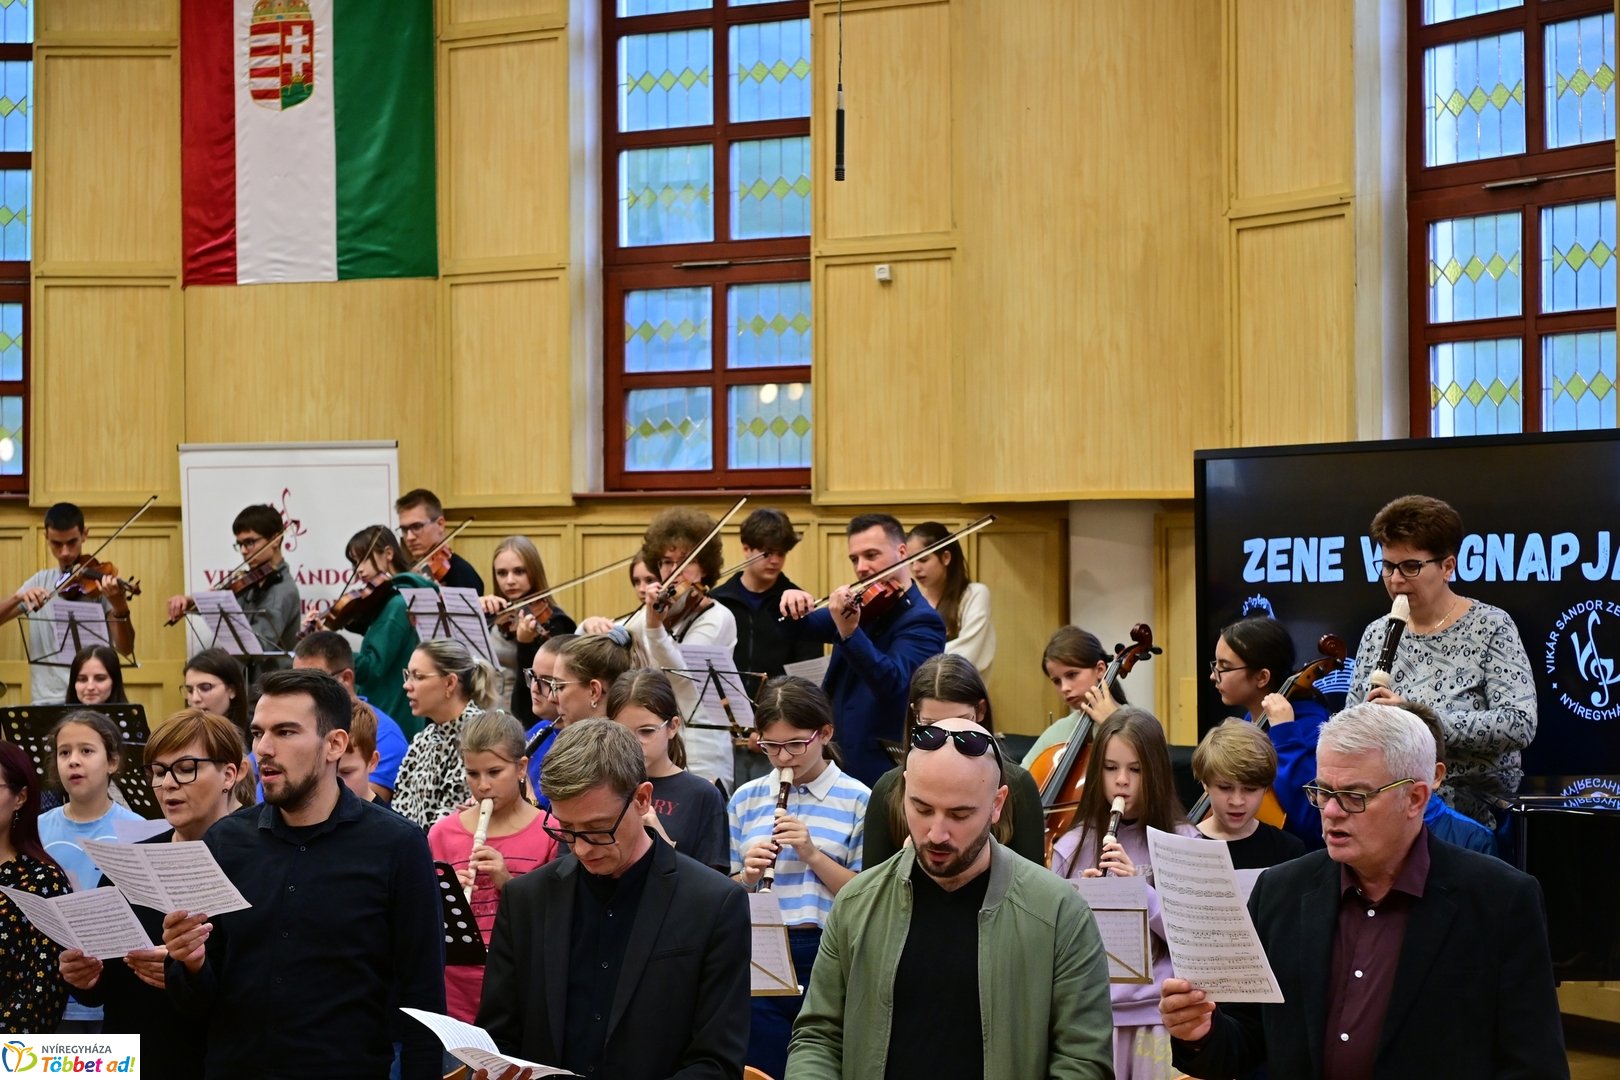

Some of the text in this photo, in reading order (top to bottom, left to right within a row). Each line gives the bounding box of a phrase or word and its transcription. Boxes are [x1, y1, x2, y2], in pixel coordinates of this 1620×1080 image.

[295, 564, 361, 585] ÁNDO
[1243, 531, 1620, 582] ZENE VGNAPJ
[1546, 630, 1560, 674] VIKÁR
[1556, 600, 1603, 630] SÁNDOR
[654, 799, 680, 816] RY
